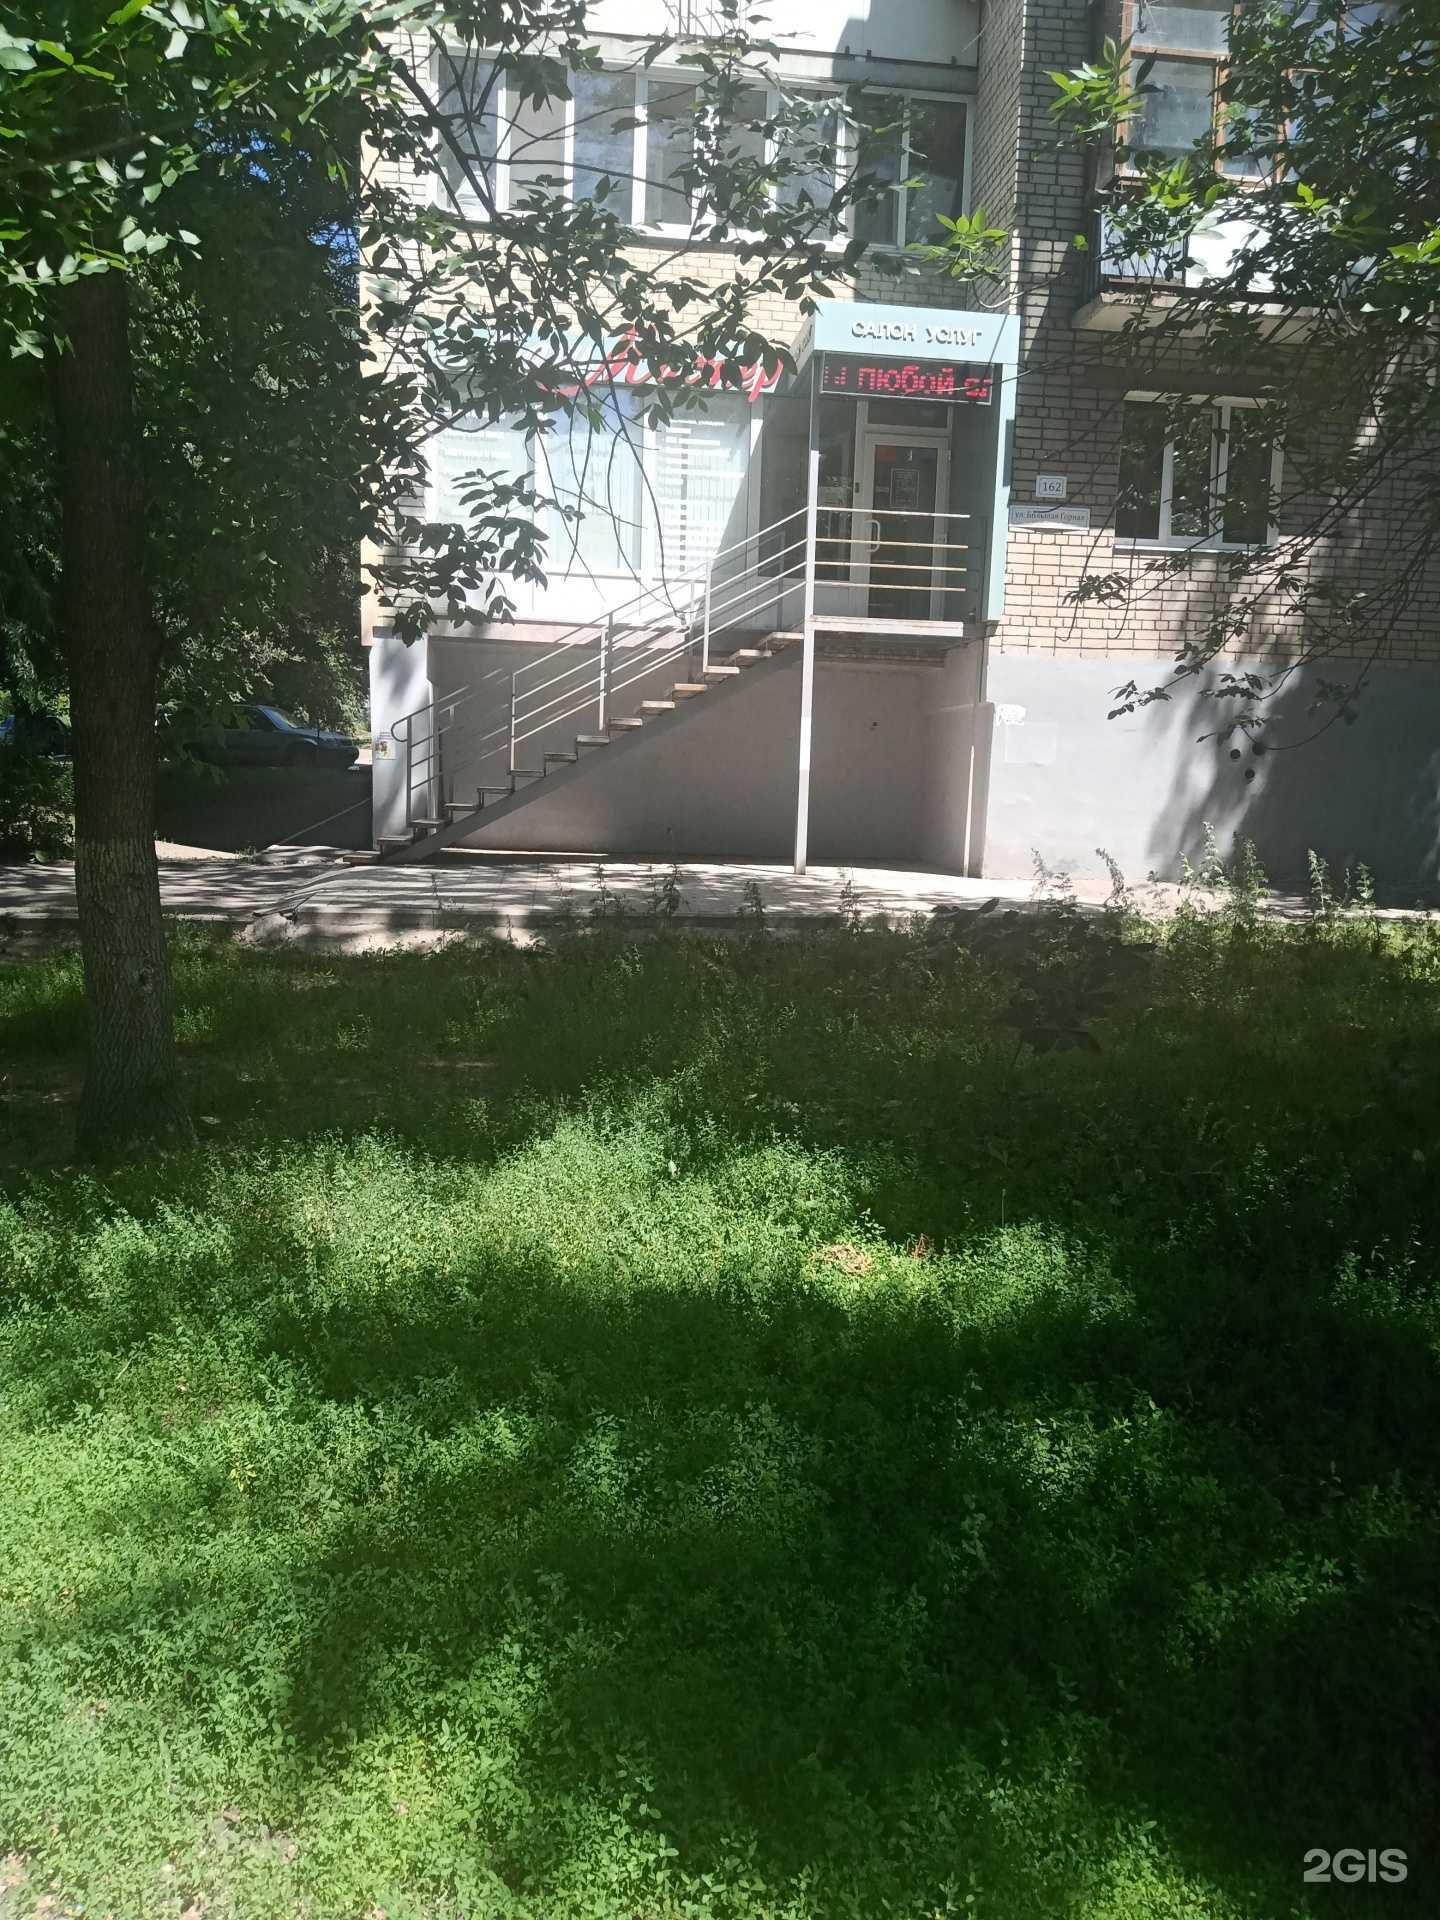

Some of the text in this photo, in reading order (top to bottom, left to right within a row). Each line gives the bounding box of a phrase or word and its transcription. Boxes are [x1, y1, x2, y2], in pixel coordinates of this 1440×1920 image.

[851, 320, 983, 346] САЛОН УСЛУГ
[1043, 481, 1062, 492] 162
